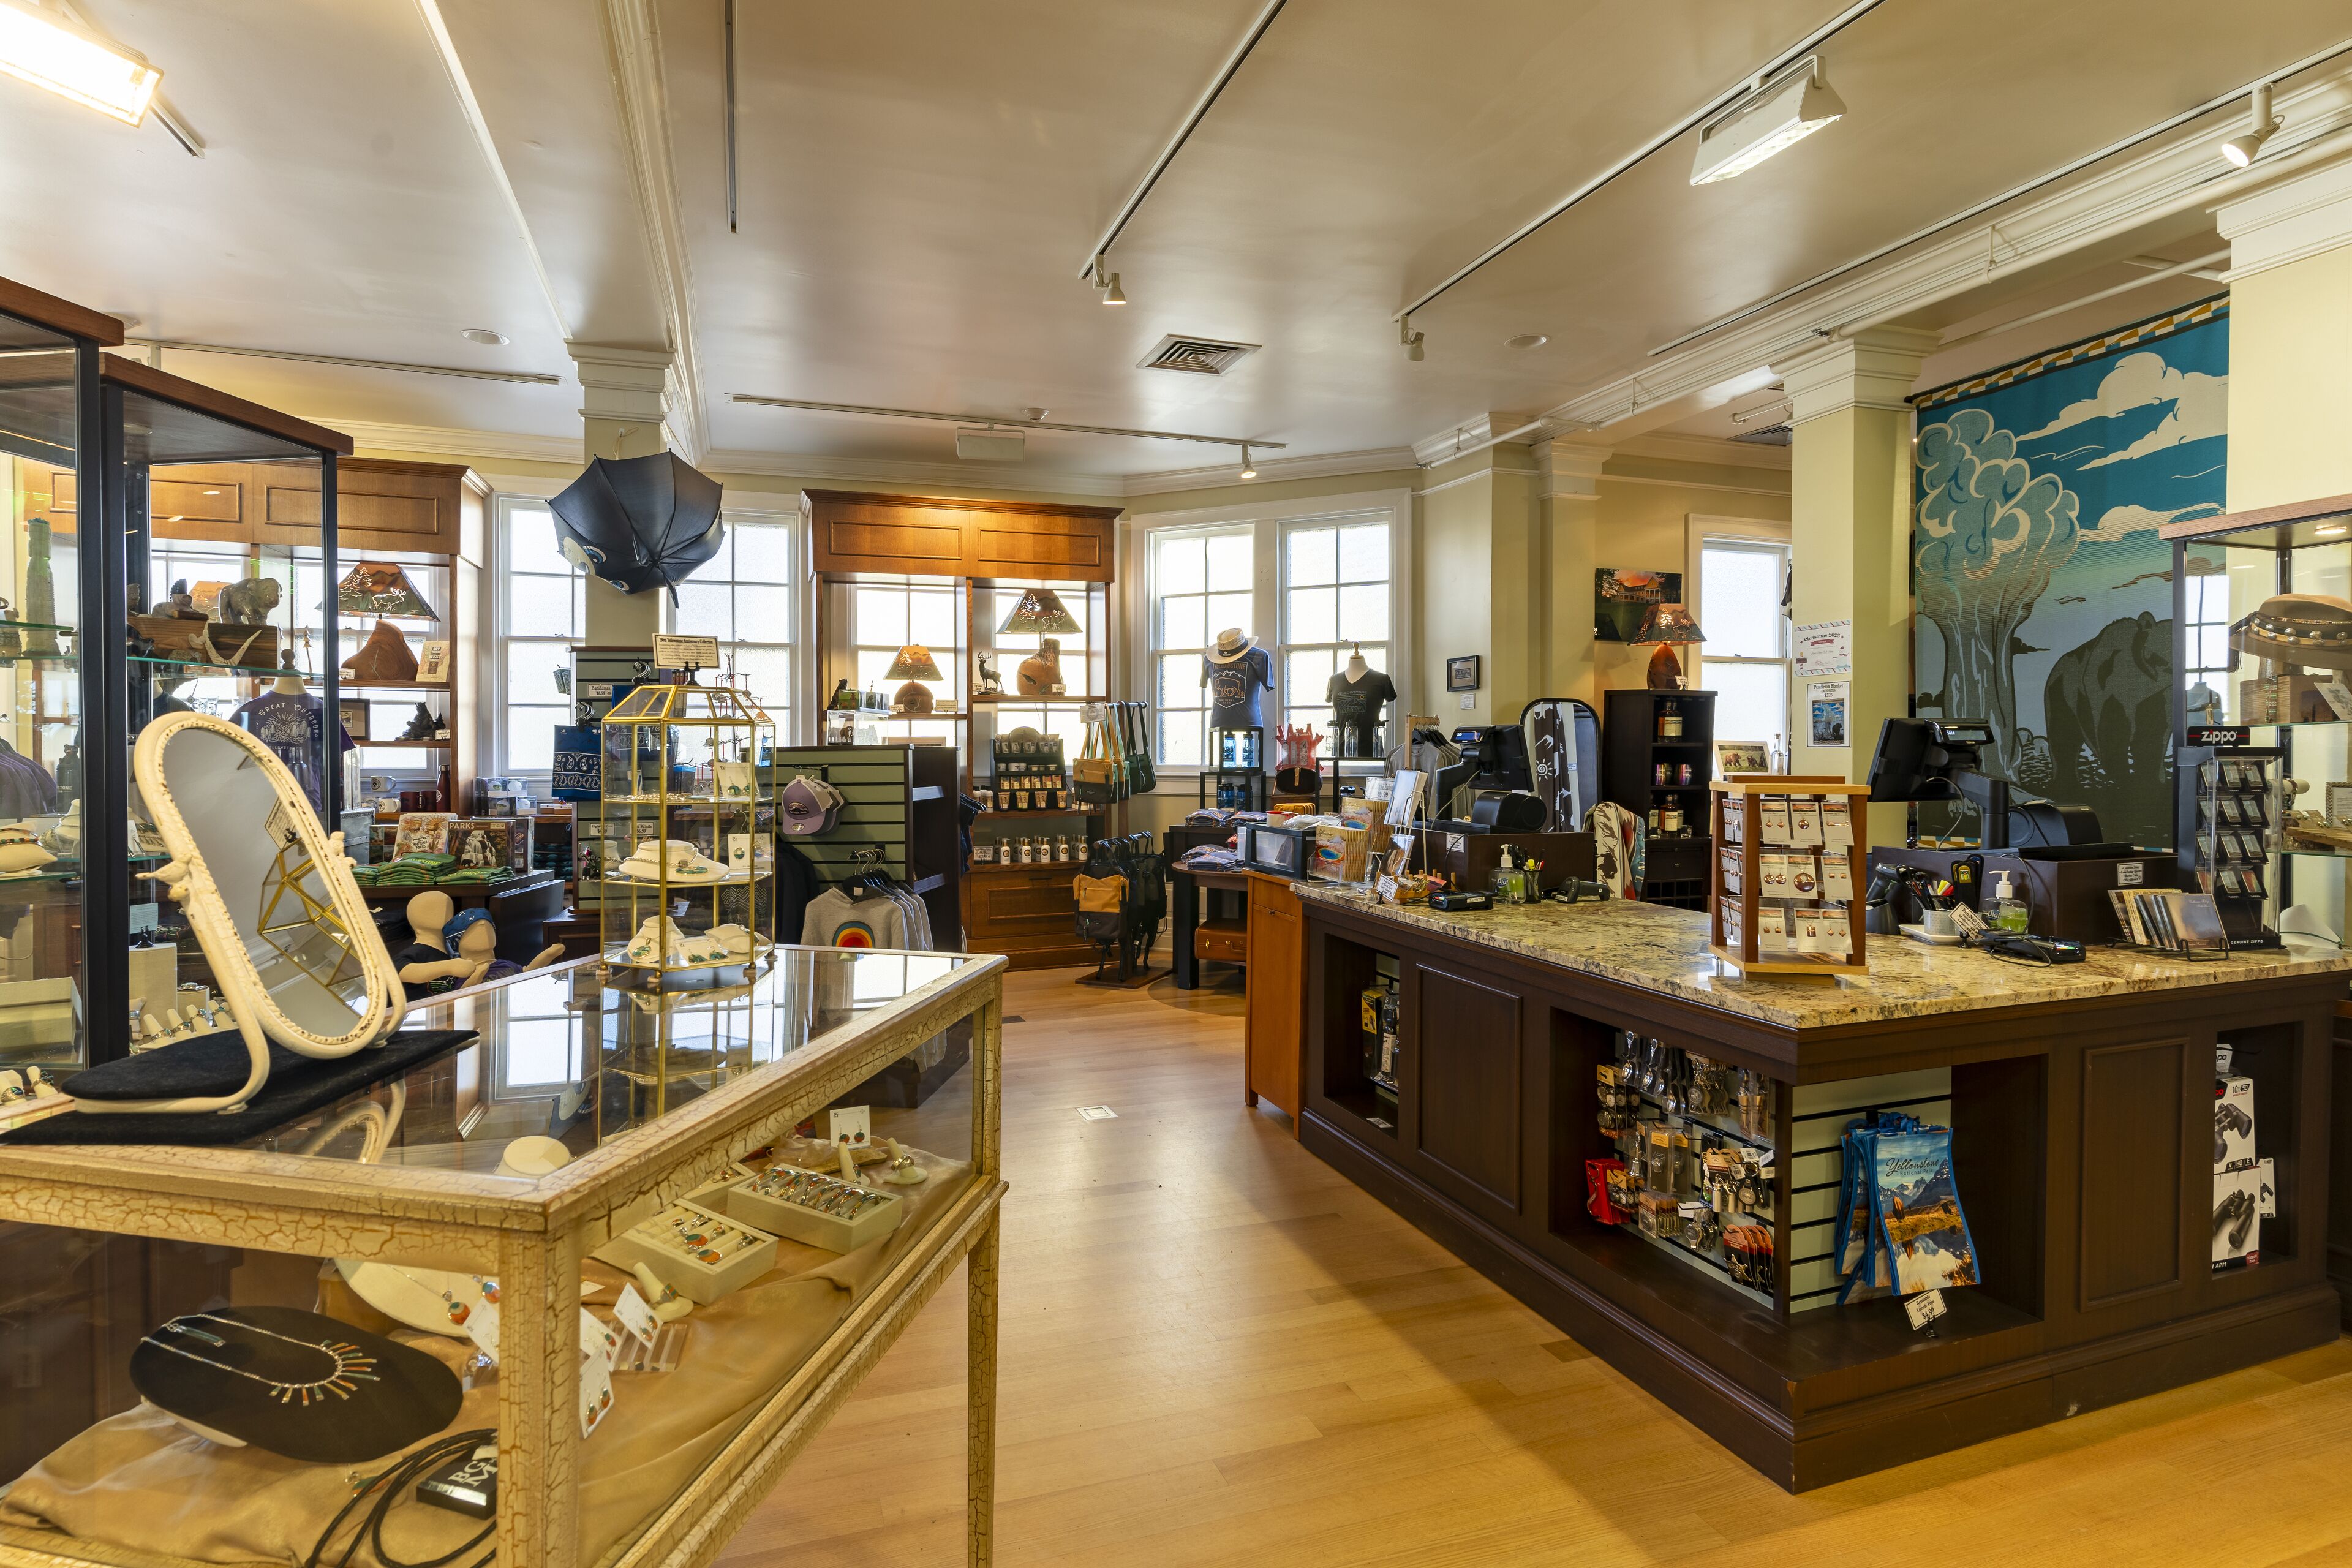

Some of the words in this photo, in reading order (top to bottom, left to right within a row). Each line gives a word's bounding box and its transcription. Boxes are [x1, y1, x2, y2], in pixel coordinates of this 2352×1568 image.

[258, 703, 285, 716] GREAT
[294, 704, 319, 737] OUTDOORS
[1961, 908, 1970, 918] Fun
[1969, 915, 1978, 924] Nail
[1988, 910, 2000, 918] Dial
[1886, 1157, 1939, 1177] Yellowstone
[1916, 1295, 1931, 1305] Reusable
[1916, 1303, 1928, 1312] Lunch
